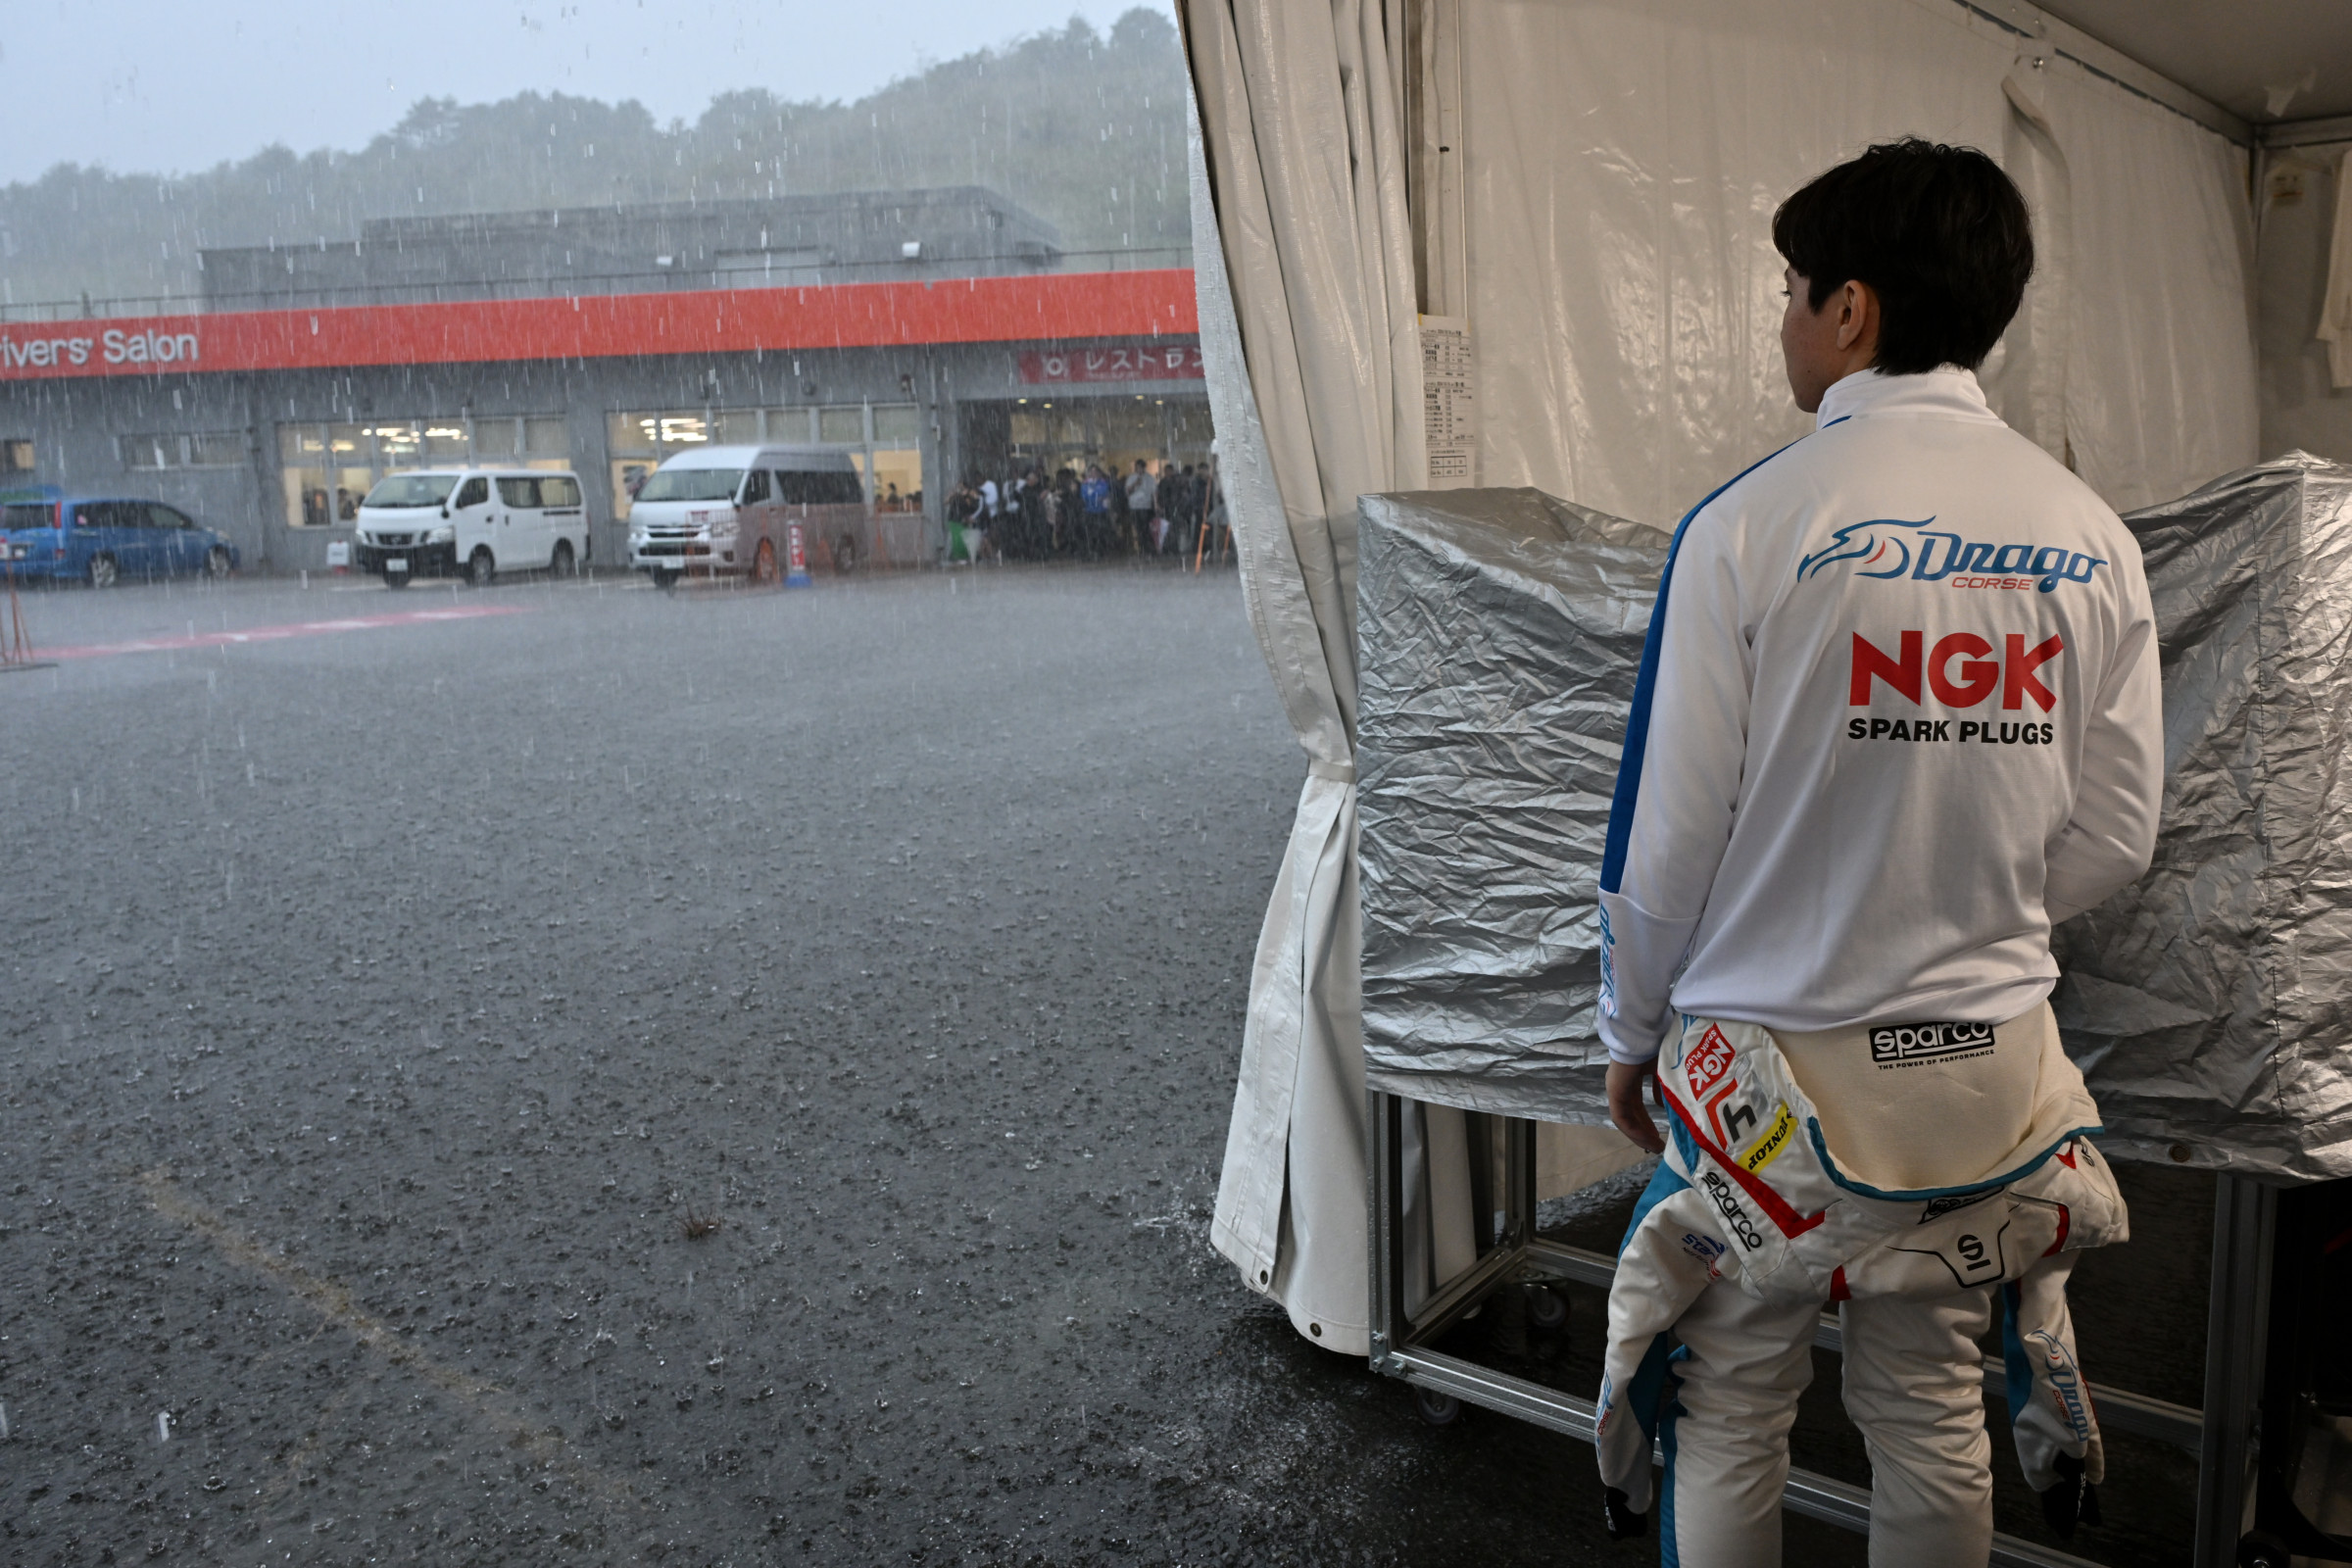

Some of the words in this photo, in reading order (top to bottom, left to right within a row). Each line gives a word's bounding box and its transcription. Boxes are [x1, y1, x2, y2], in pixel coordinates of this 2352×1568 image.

[0, 334, 94, 368] ivers'
[103, 328, 199, 364] Salon
[1910, 530, 2108, 593] Drago
[1951, 576, 2034, 591] CORSE
[1848, 630, 2064, 713] NGK
[1847, 717, 1951, 743] SPARK
[1958, 720, 2054, 745] PLUGS
[1700, 1029, 1717, 1054] SPARK
[1874, 1021, 1991, 1058] sparco
[1896, 1059, 1924, 1068] POWER
[1939, 1049, 1995, 1064] PERFORMANCE
[1686, 1052, 1703, 1071] PLUG
[1689, 1038, 1733, 1091] NGK
[1747, 1117, 1788, 1170] DUNLOP
[1702, 1171, 1763, 1250] sparco
